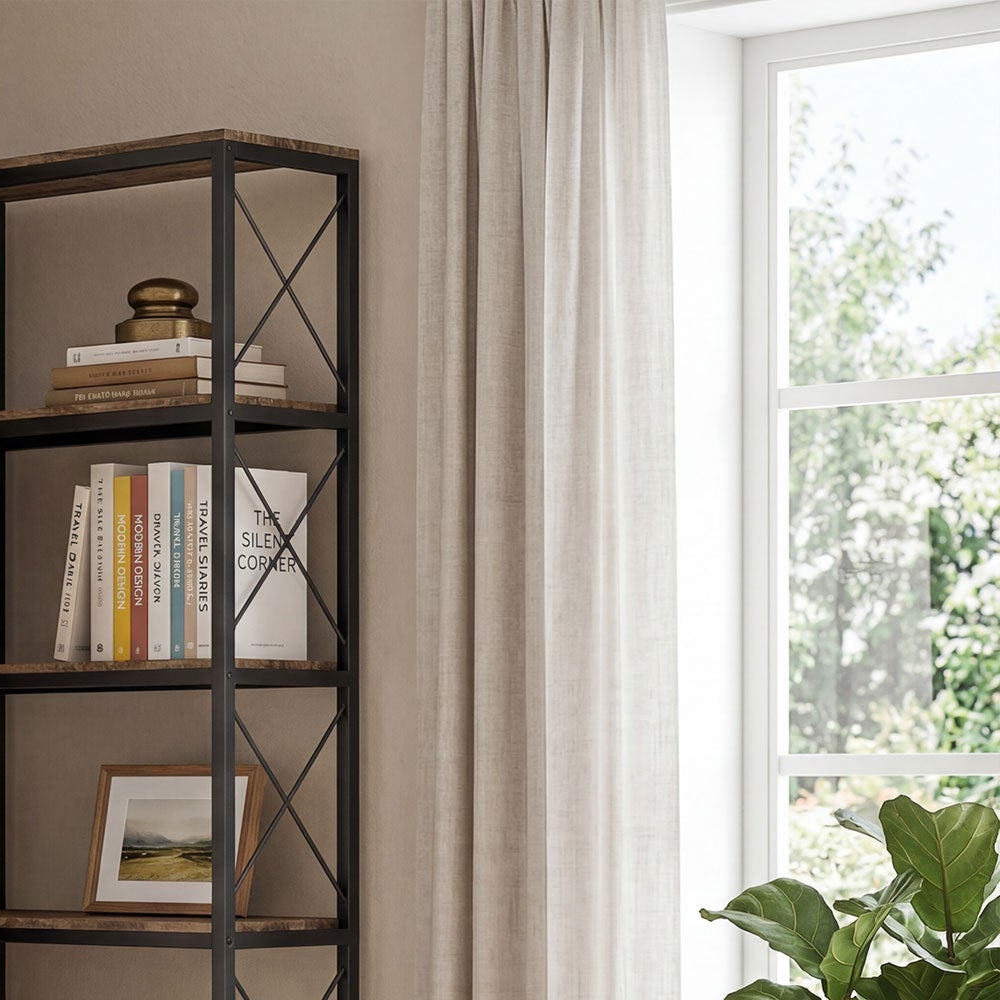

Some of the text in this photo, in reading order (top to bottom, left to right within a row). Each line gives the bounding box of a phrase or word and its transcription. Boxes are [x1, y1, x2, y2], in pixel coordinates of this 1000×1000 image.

[71, 503, 83, 547] TRAVEL
[254, 510, 280, 526] THE
[242, 532, 293, 548] SILEN
[199, 500, 208, 612] TRAVEL SIARIES
[238, 554, 296, 573] CORNER
